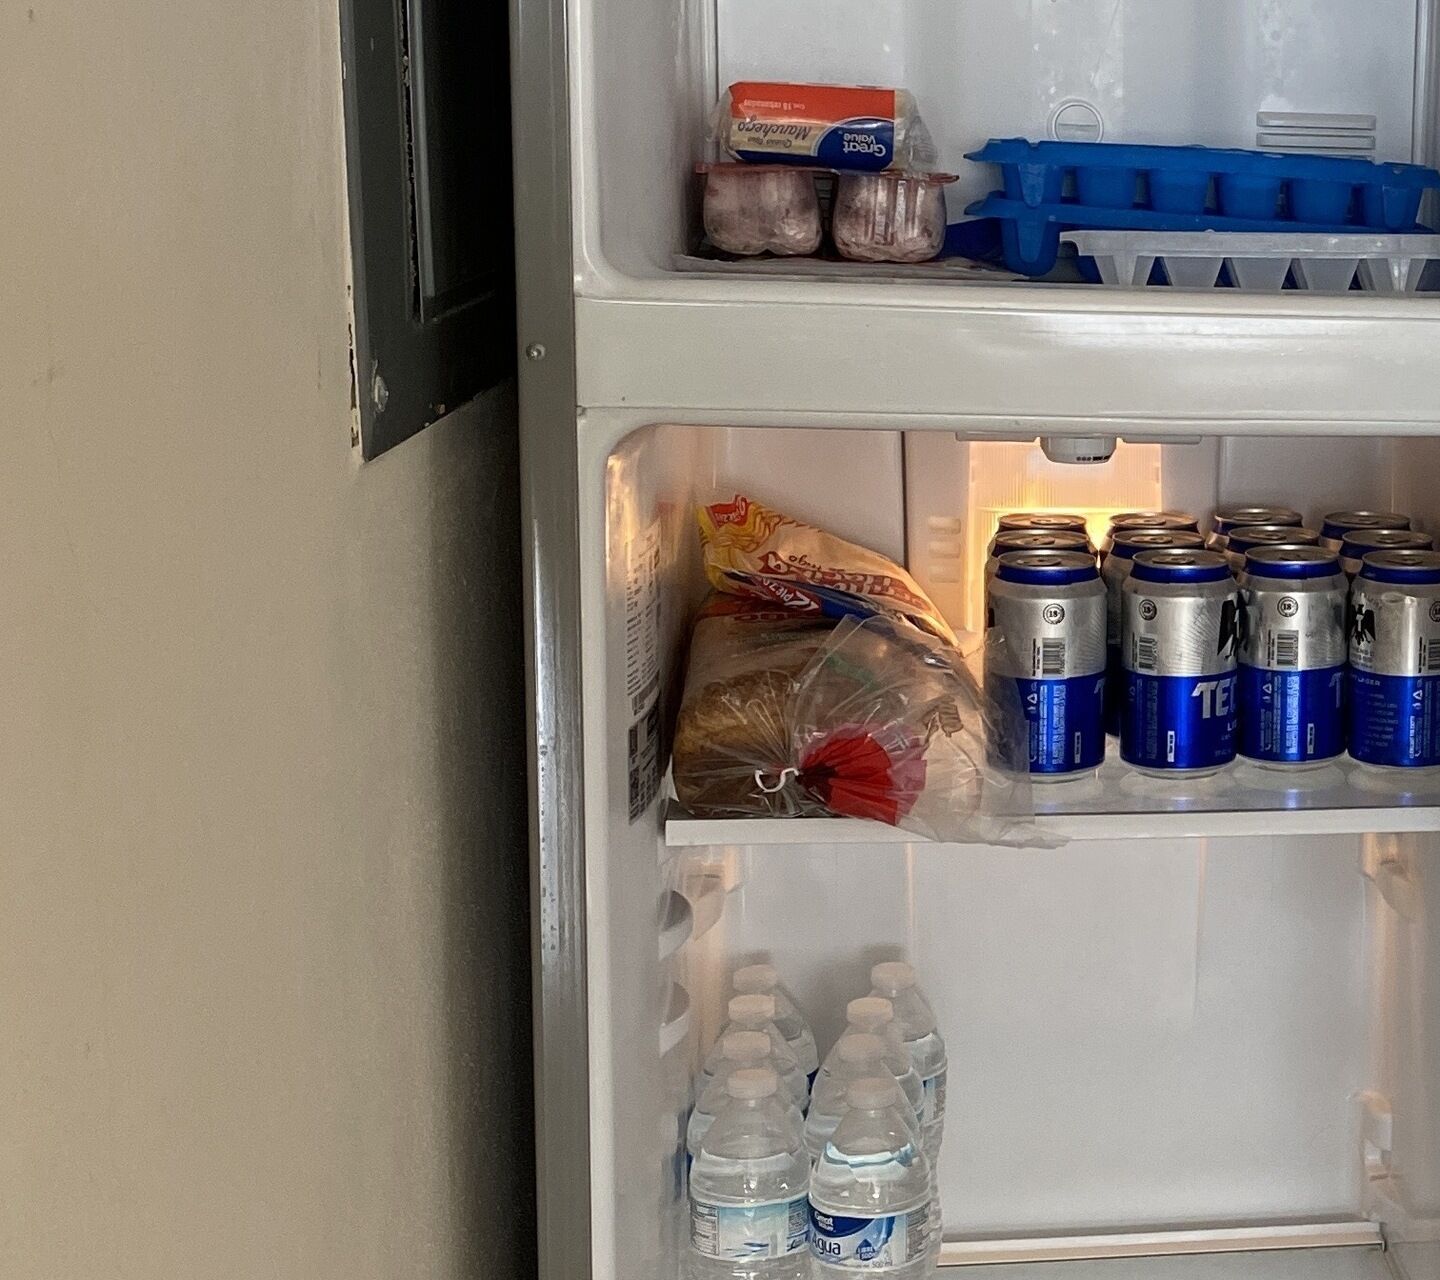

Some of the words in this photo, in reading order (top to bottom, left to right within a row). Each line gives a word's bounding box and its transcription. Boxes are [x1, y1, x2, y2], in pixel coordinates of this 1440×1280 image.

[738, 114, 812, 142] Manchego
[843, 132, 878, 145] Value
[843, 141, 887, 157] Great
[812, 1231, 841, 1256] Agua
